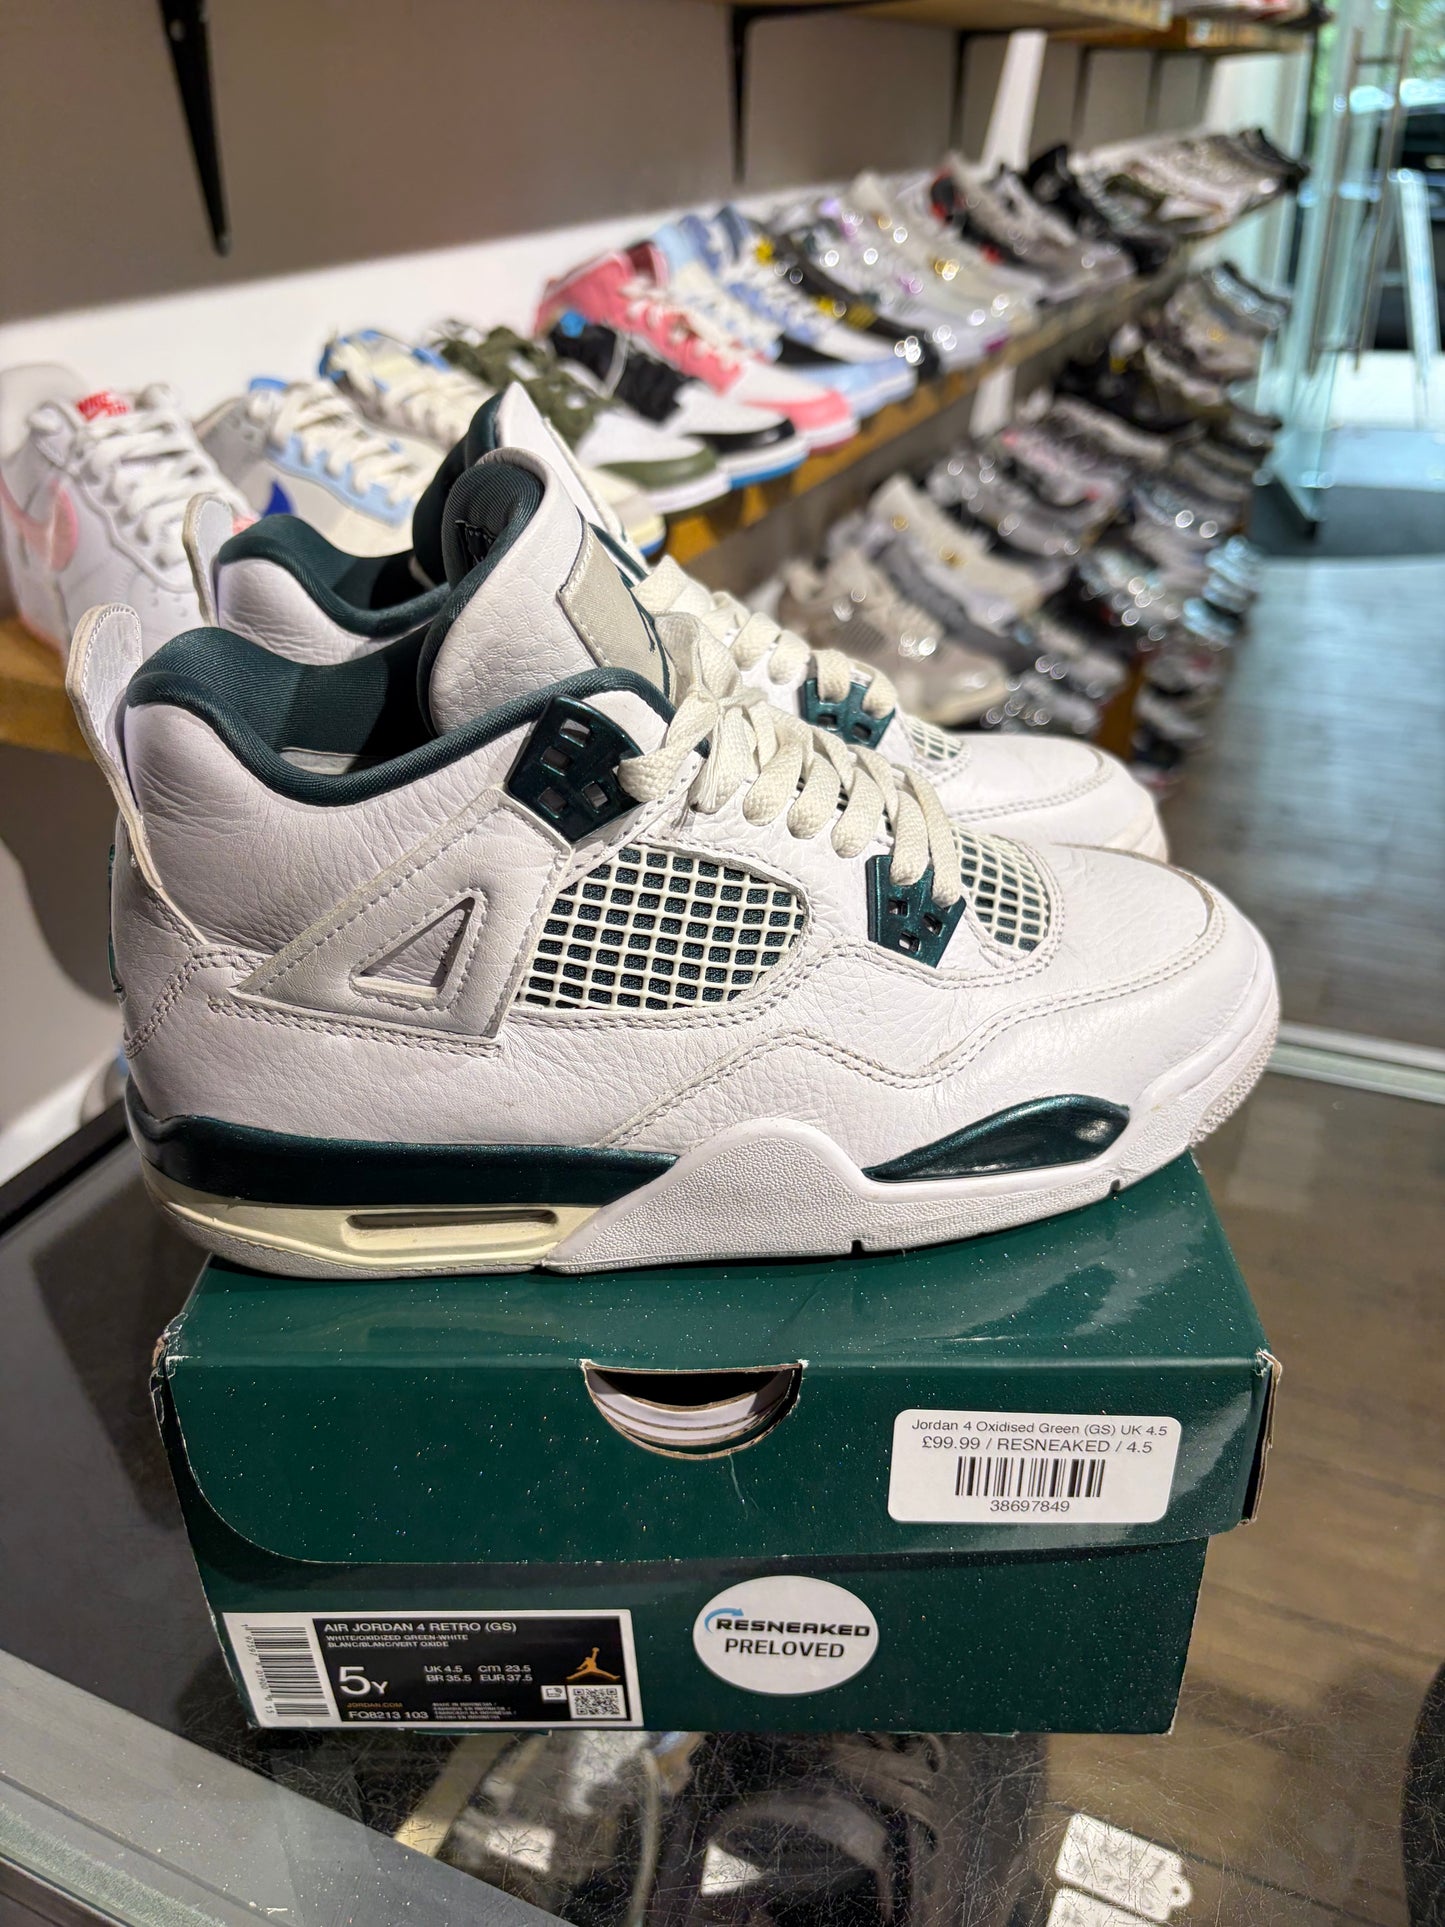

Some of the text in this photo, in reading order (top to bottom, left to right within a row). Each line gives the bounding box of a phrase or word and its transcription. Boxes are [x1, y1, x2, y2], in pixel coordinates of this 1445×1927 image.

[912, 1419, 1168, 1436] Jordan 4 Oxidised Green (GS) UK 4.5
[922, 1435, 1153, 1454] £99.99 / RESNEAKED / 4.5
[990, 1500, 1070, 1513] 38697849
[324, 1622, 517, 1633] AIR JORDAN 4 RETRO (GS)
[716, 1618, 871, 1637] RESNEAKED
[724, 1638, 845, 1658] PRELOVED
[424, 1665, 442, 1673] UK
[444, 1665, 463, 1673] 4.5
[426, 1674, 533, 1682] BR 35.5 EUR 37.5
[349, 1711, 401, 1719] FQ8213
[404, 1711, 429, 1719] 103
